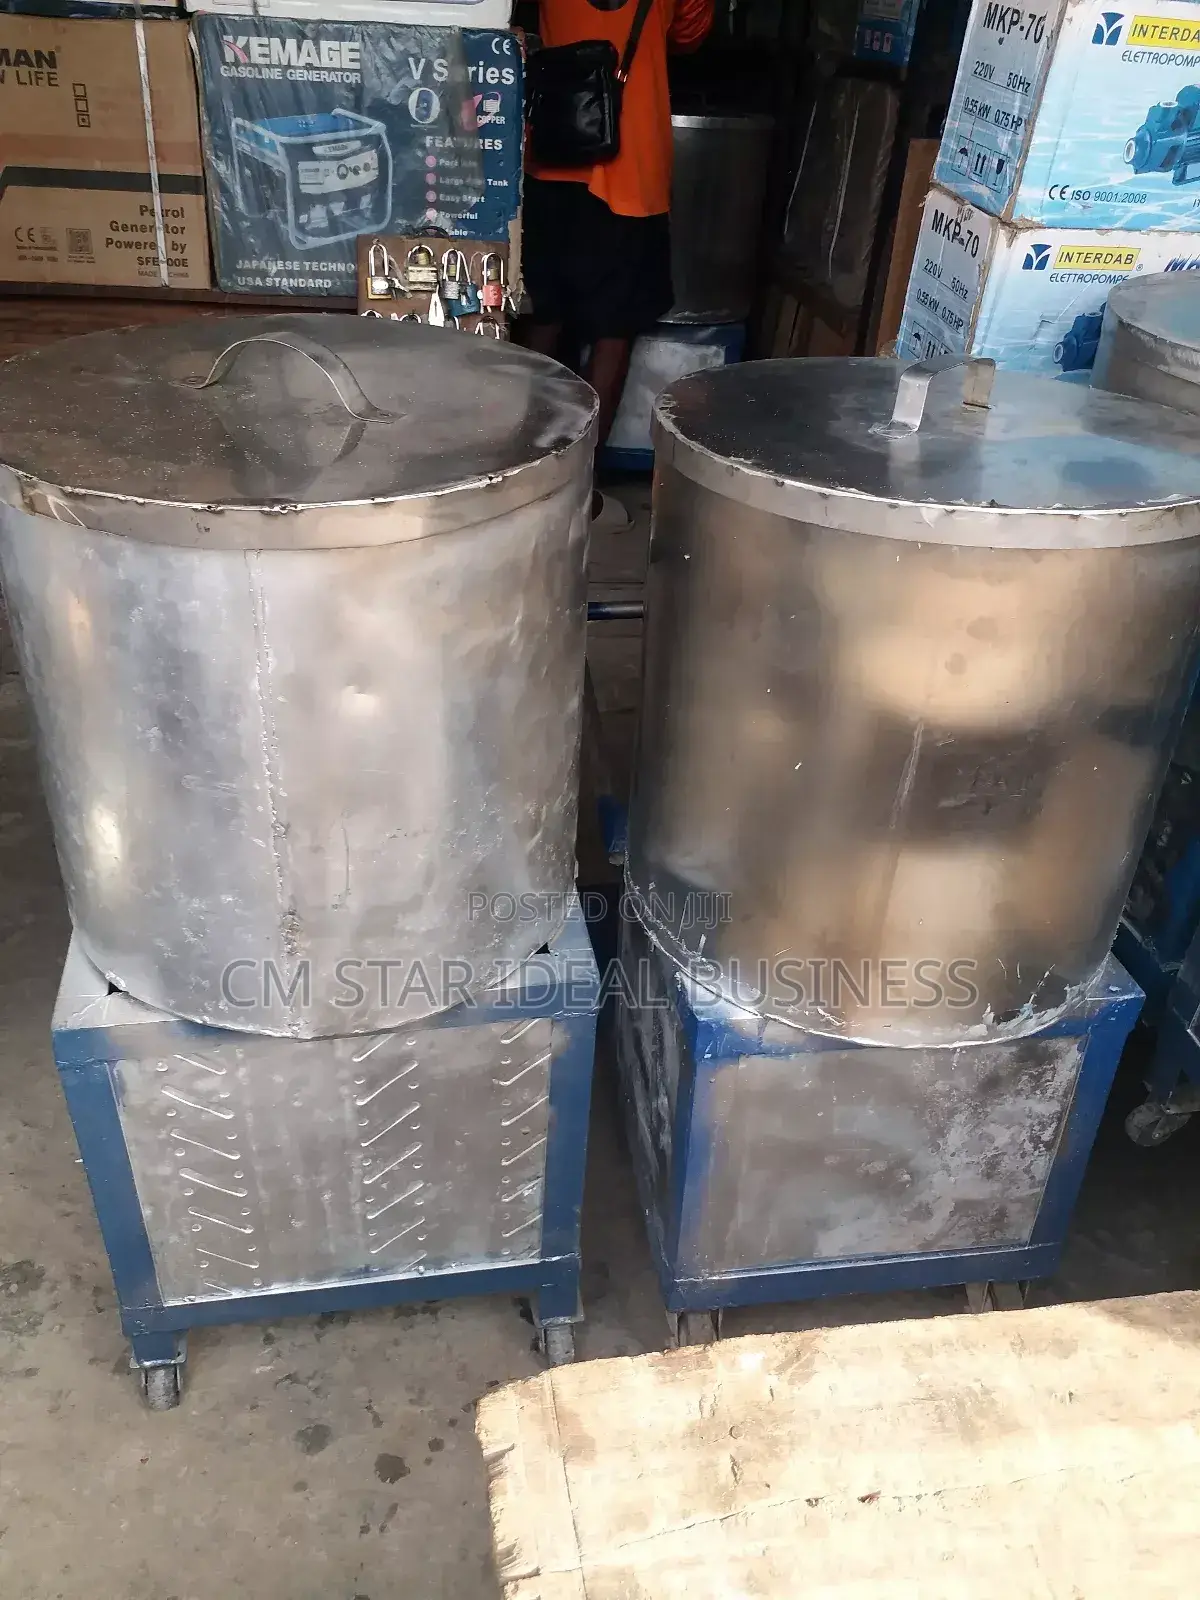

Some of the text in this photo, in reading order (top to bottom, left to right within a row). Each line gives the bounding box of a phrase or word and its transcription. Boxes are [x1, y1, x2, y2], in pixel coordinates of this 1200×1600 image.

[983, 2, 1048, 44] MKP-70
[1132, 24, 1200, 43] INTERDA
[221, 35, 361, 70] KEMAGE
[1121, 50, 1200, 67] ELETTROPOMP
[15, 70, 60, 87] LIFE
[220, 65, 361, 84] GASOLINE GENERATOR
[408, 57, 515, 85] V Sries
[973, 60, 1031, 93] 220V 50Hz
[476, 115, 505, 125] COPPER
[425, 136, 503, 151] FEARES
[487, 178, 509, 187] Tank
[440, 193, 485, 203] Easy Start
[1071, 190, 1091, 200] ISO
[1094, 191, 1147, 204] 9001:2008
[439, 211, 478, 220] Powerful
[109, 220, 186, 235] Genertor
[931, 208, 979, 258] MKP-70
[105, 237, 187, 254] Powere by
[137, 256, 189, 268] SFE00E
[236, 259, 300, 272] JAPANESE
[1058, 251, 1134, 265] INTERDAB
[237, 276, 332, 288] USA STANDARD
[923, 258, 969, 300] 220V 50Hz
